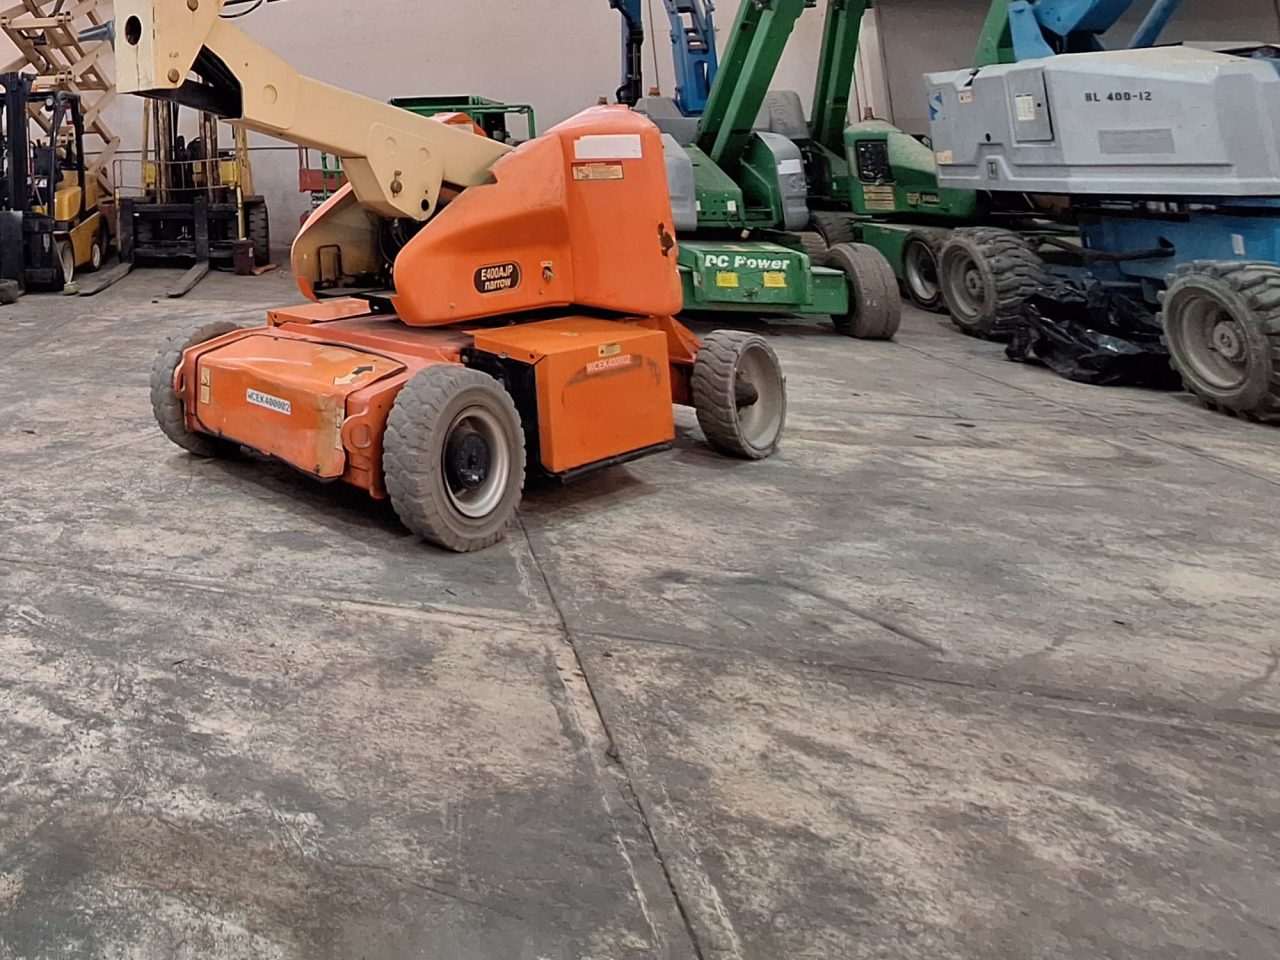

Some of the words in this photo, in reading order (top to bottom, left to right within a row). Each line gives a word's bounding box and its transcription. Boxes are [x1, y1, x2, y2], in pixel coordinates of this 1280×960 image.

[1085, 92, 1100, 101] BL
[1107, 91, 1152, 101] 400-12
[734, 255, 790, 269] Power
[481, 265, 513, 280] E400AJP
[484, 278, 512, 290] narrow
[247, 391, 290, 413] WCEK400002
